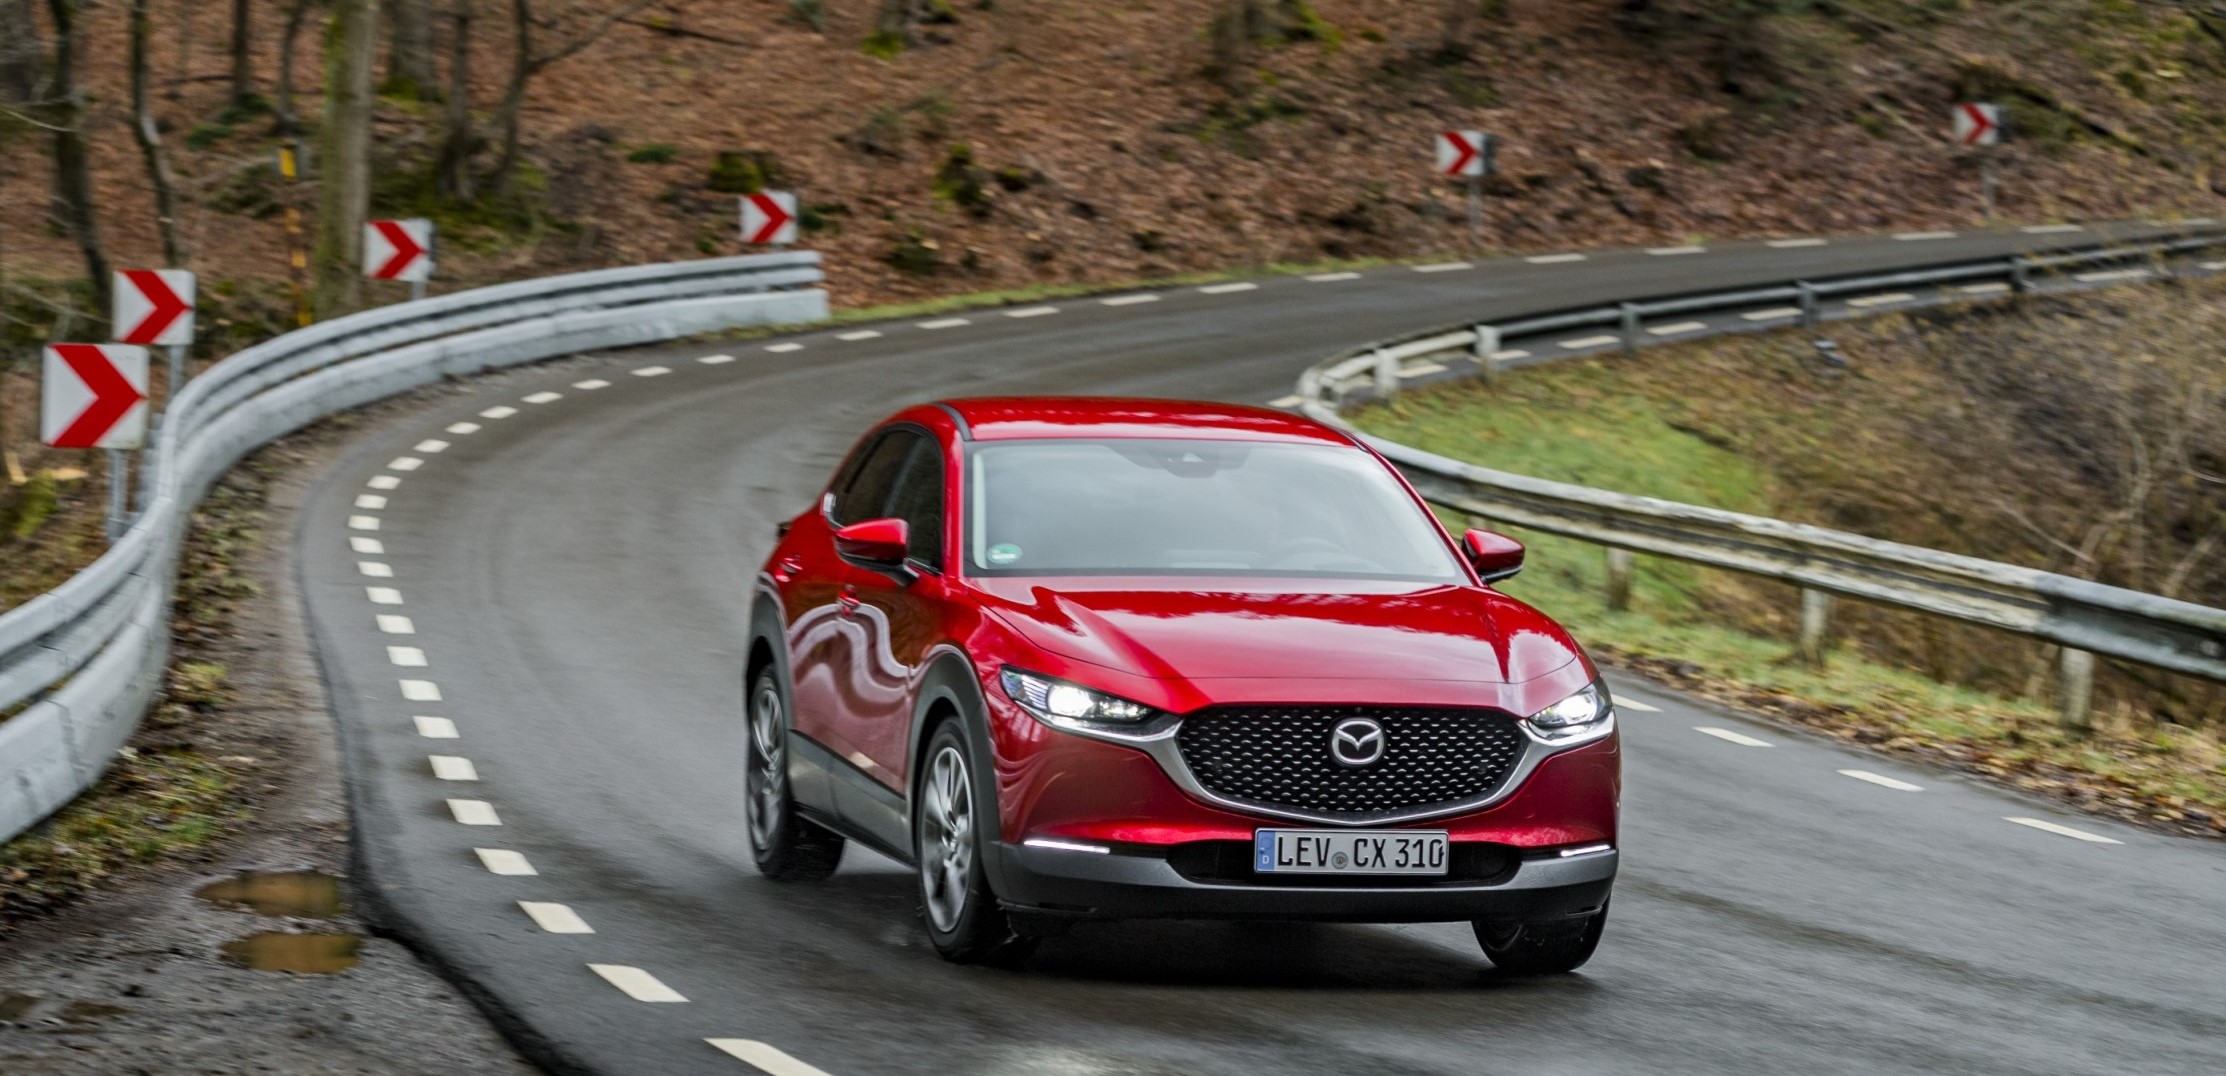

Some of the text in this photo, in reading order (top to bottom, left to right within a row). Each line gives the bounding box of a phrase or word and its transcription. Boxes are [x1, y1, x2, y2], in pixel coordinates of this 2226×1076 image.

[1277, 837, 1444, 868] LEV CX 310
